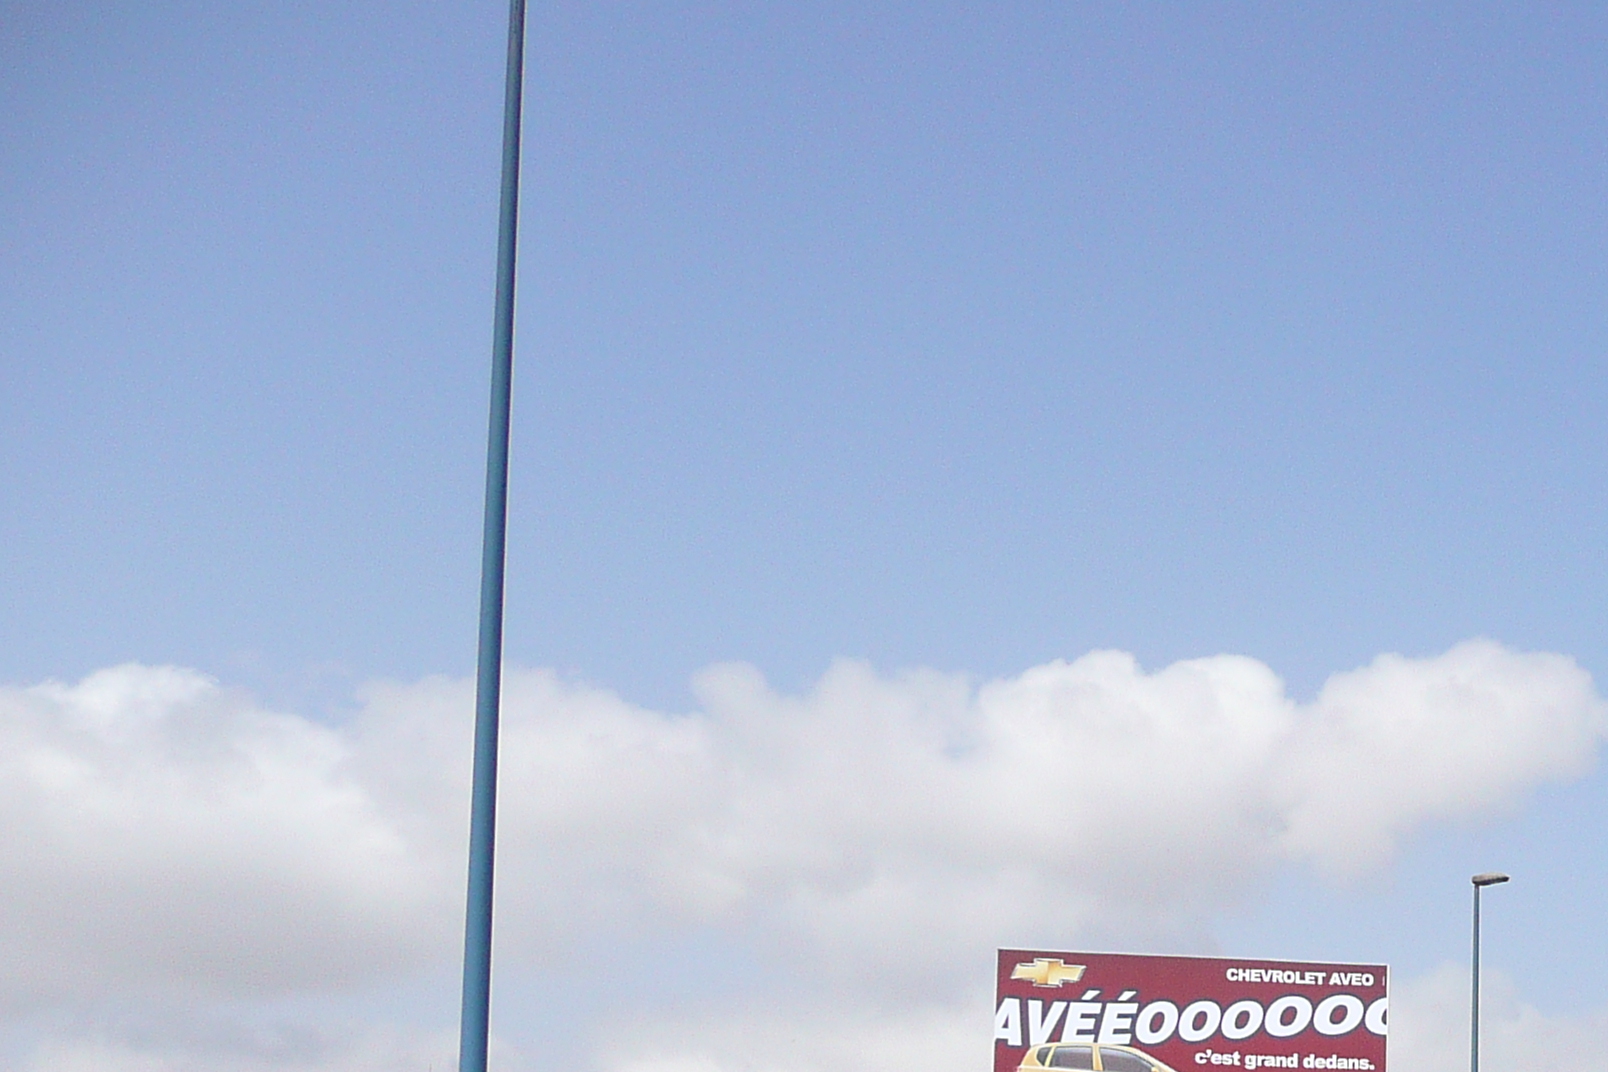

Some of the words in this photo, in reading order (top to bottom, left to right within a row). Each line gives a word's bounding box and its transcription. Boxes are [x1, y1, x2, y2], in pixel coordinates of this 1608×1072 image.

[1226, 968, 1327, 985] CHEVROLET
[1329, 972, 1375, 986] AVEO
[1244, 1053, 1299, 1070] grand
[1302, 1054, 1376, 1071] dedans.
